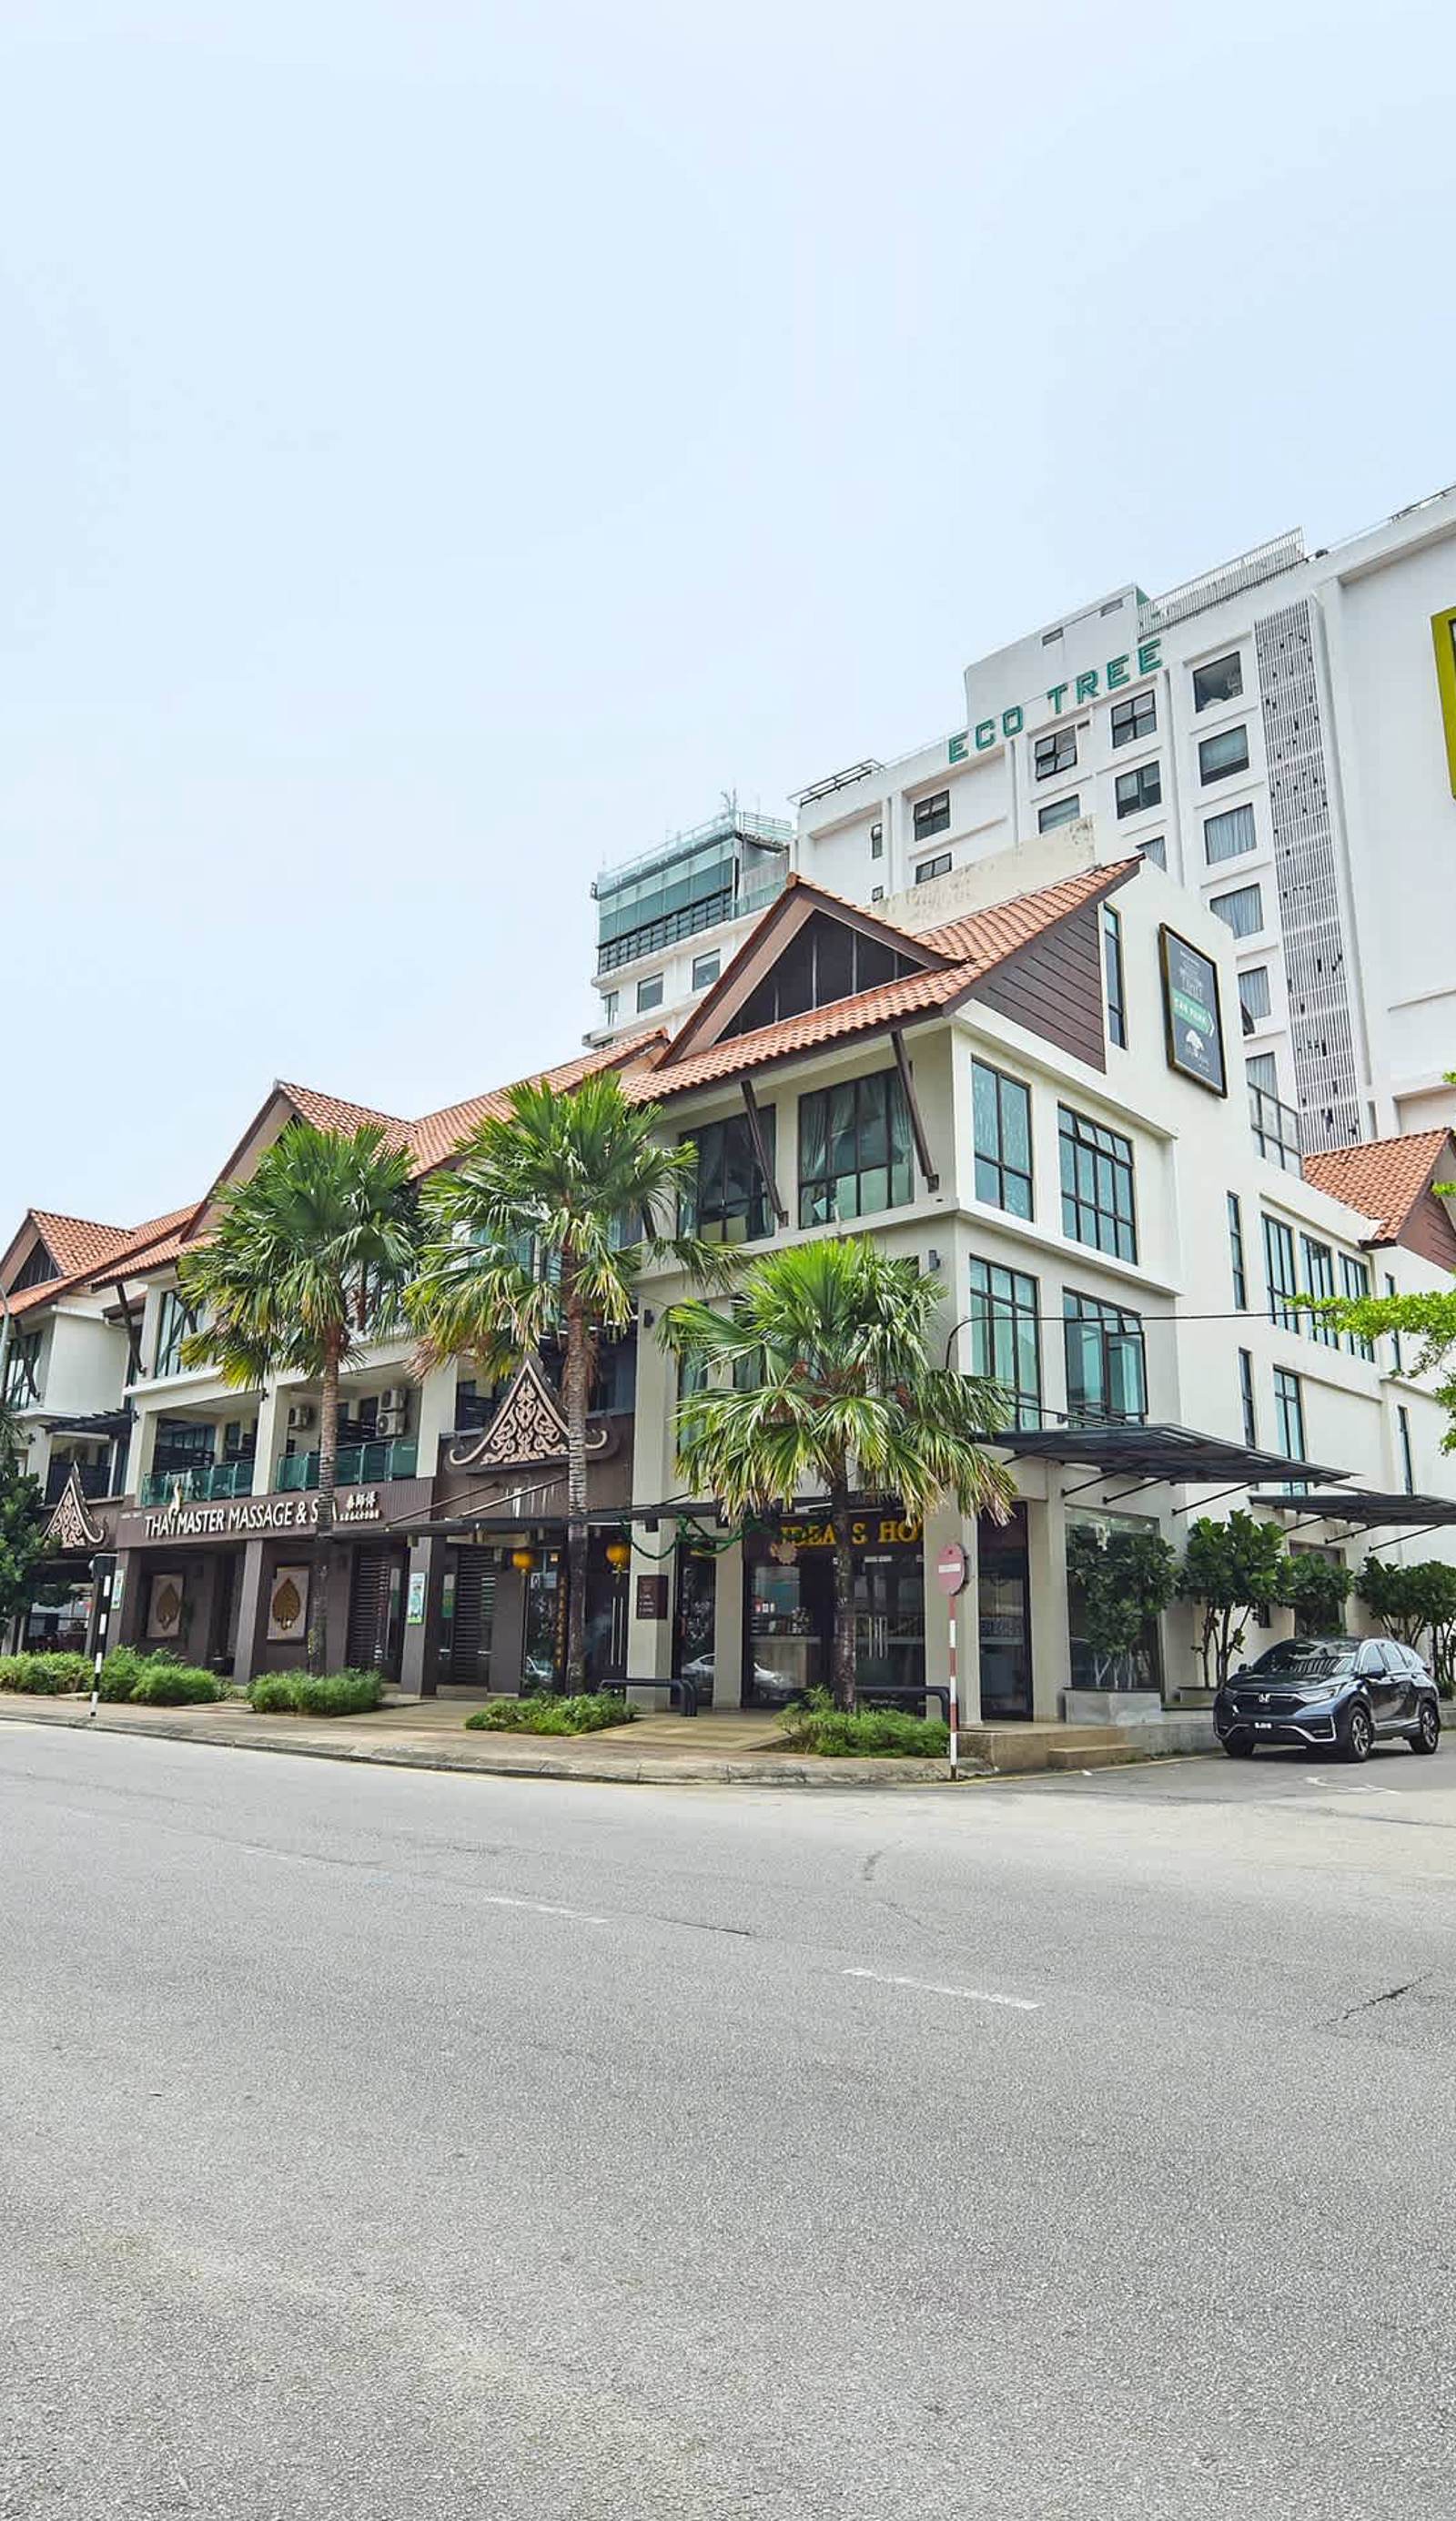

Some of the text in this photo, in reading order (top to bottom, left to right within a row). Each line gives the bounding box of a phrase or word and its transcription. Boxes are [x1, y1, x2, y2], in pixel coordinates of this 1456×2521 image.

[948, 638, 1164, 764] ECO TREE
[145, 1512, 177, 1537] THAI
[177, 1509, 225, 1535] MASTER
[228, 1501, 293, 1532] MASSAGE
[296, 1503, 308, 1524] &
